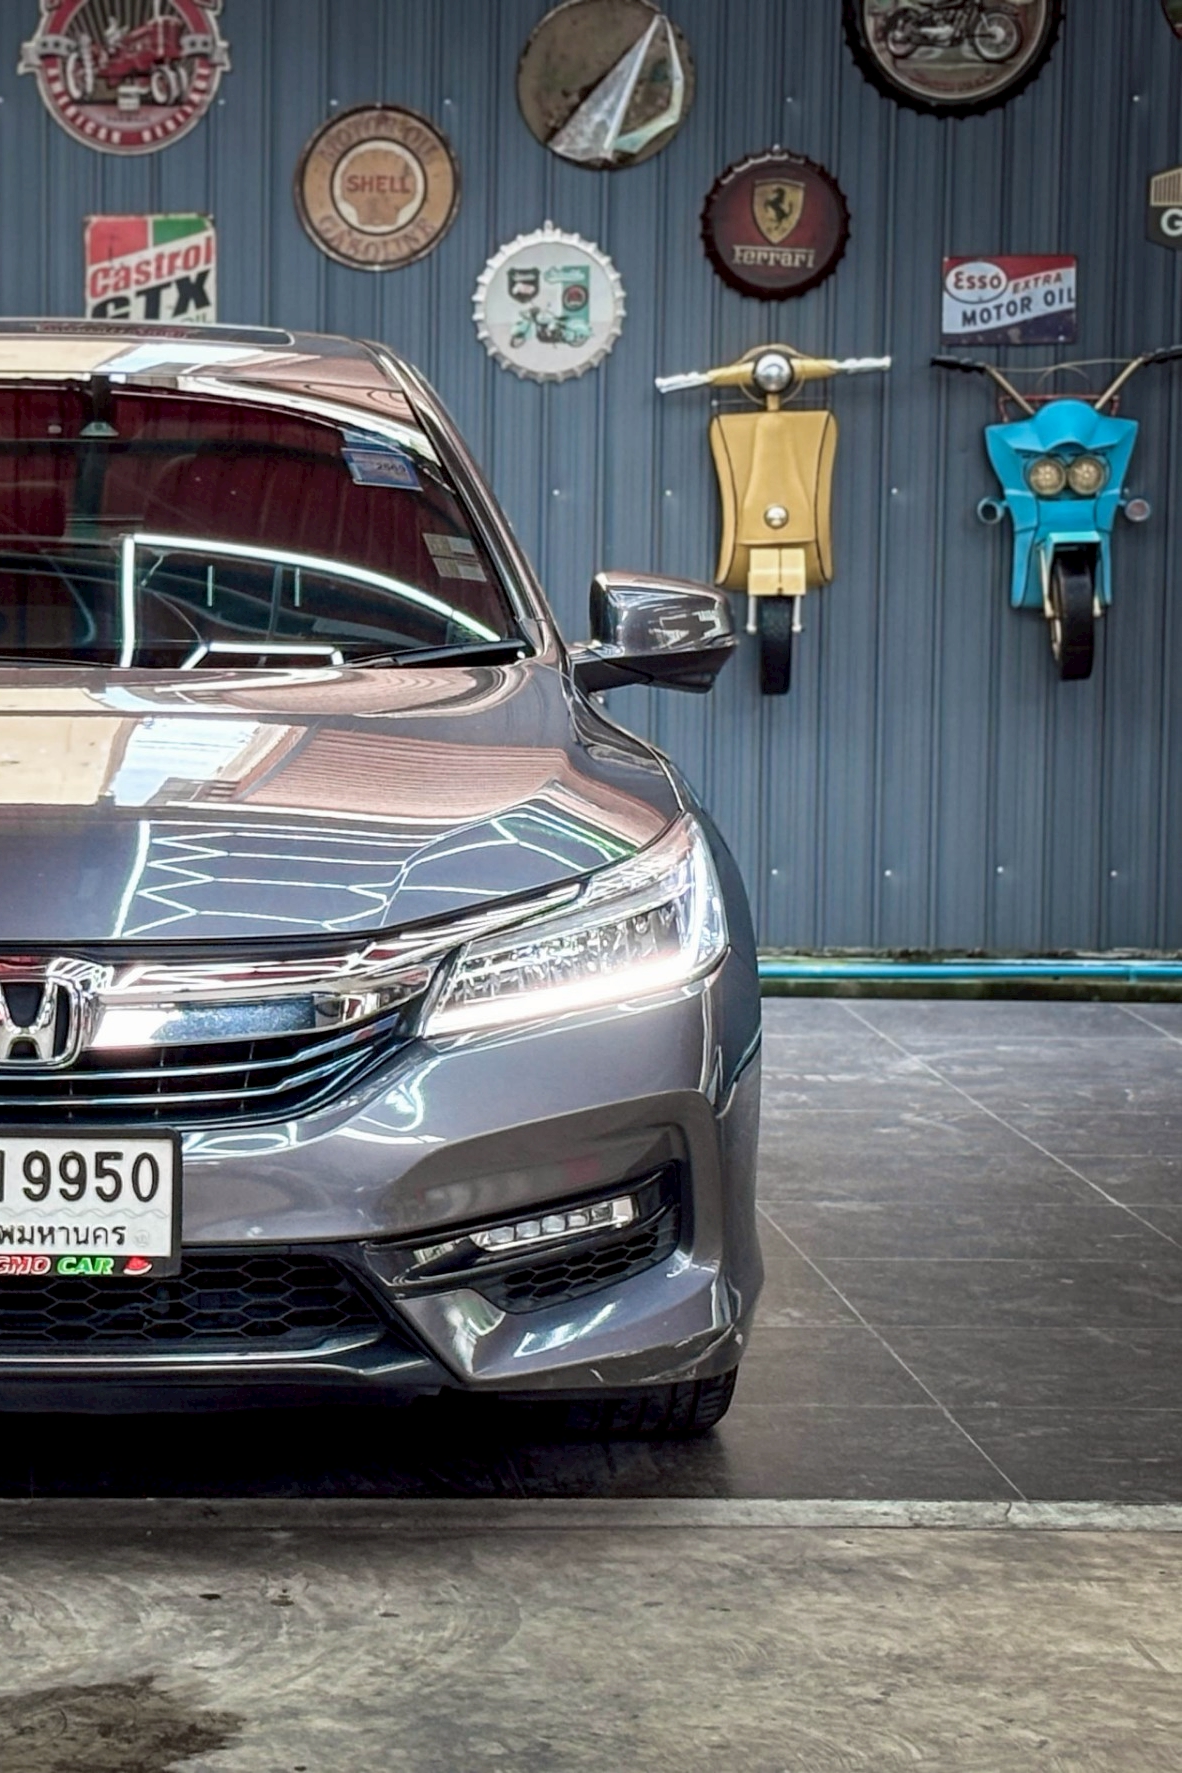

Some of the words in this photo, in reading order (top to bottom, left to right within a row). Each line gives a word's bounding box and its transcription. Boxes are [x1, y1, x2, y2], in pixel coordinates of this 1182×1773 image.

[346, 175, 411, 194] SHELL
[90, 236, 212, 299] Castrol
[732, 244, 816, 268] Ferrari
[1012, 272, 1063, 294] EXTRA
[962, 296, 1033, 327] MOTOR
[1043, 287, 1075, 307] OIL
[22, 1150, 160, 1202] 9950
[56, 1255, 115, 1275] CAR
